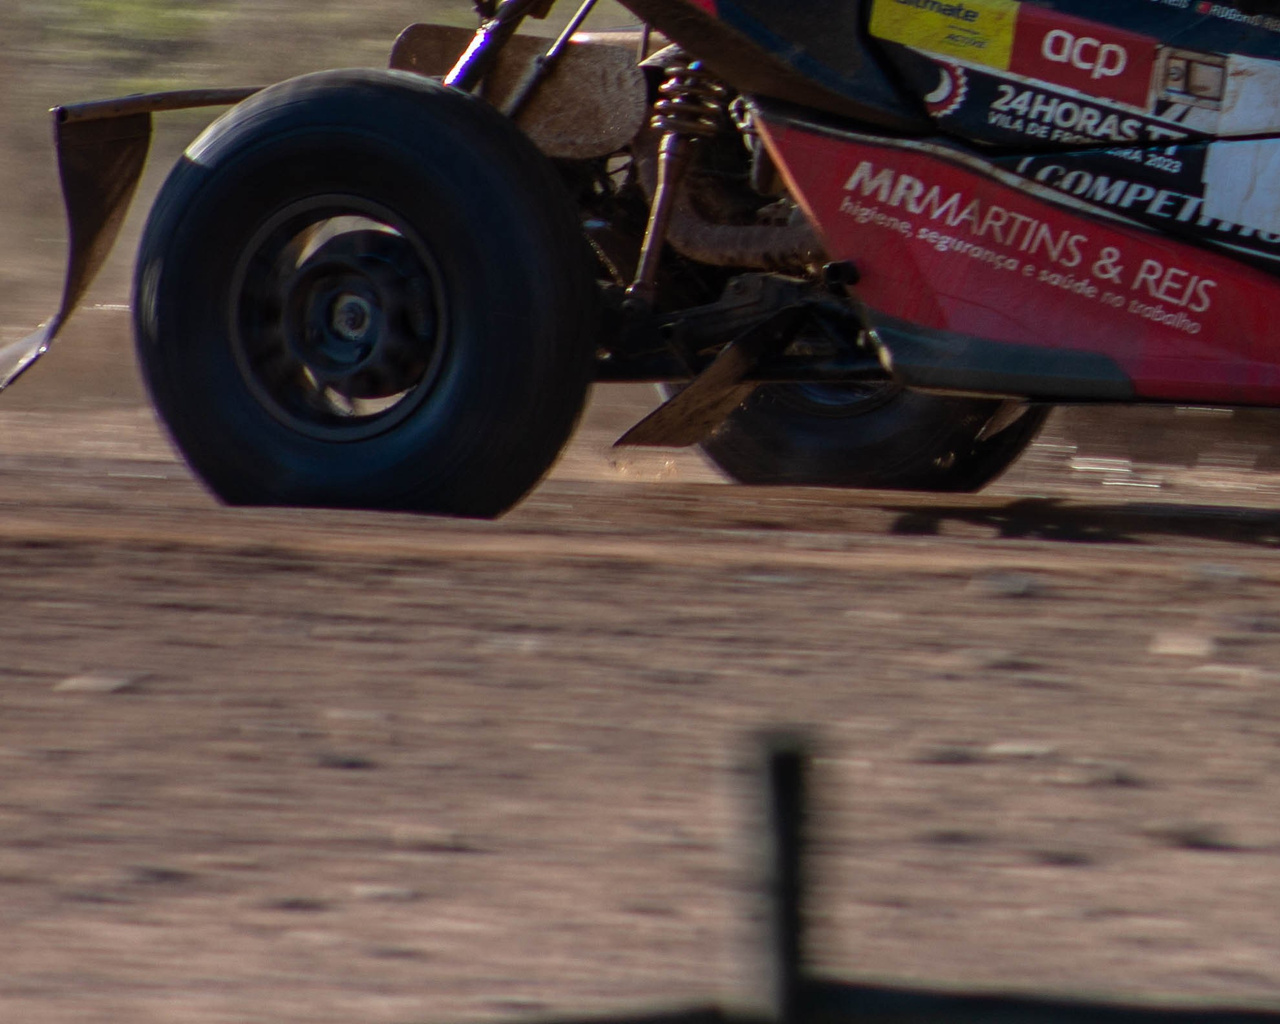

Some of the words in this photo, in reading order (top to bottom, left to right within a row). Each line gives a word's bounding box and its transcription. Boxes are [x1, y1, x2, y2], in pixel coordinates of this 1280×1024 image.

[1041, 29, 1128, 79] acp
[986, 111, 1025, 133] VILA
[1024, 122, 1050, 139] DE
[1143, 153, 1184, 175] 2023
[988, 83, 1144, 143] 24HORAS
[839, 195, 914, 239] higiene,
[915, 227, 1021, 272] segurança
[1021, 263, 1037, 277] e
[1036, 267, 1099, 299] saúde
[1099, 291, 1127, 308] no
[1126, 298, 1202, 336] trabalho
[843, 160, 1089, 268] MRMARTINS
[1091, 246, 1125, 285] &
[1129, 258, 1219, 313] REIS
